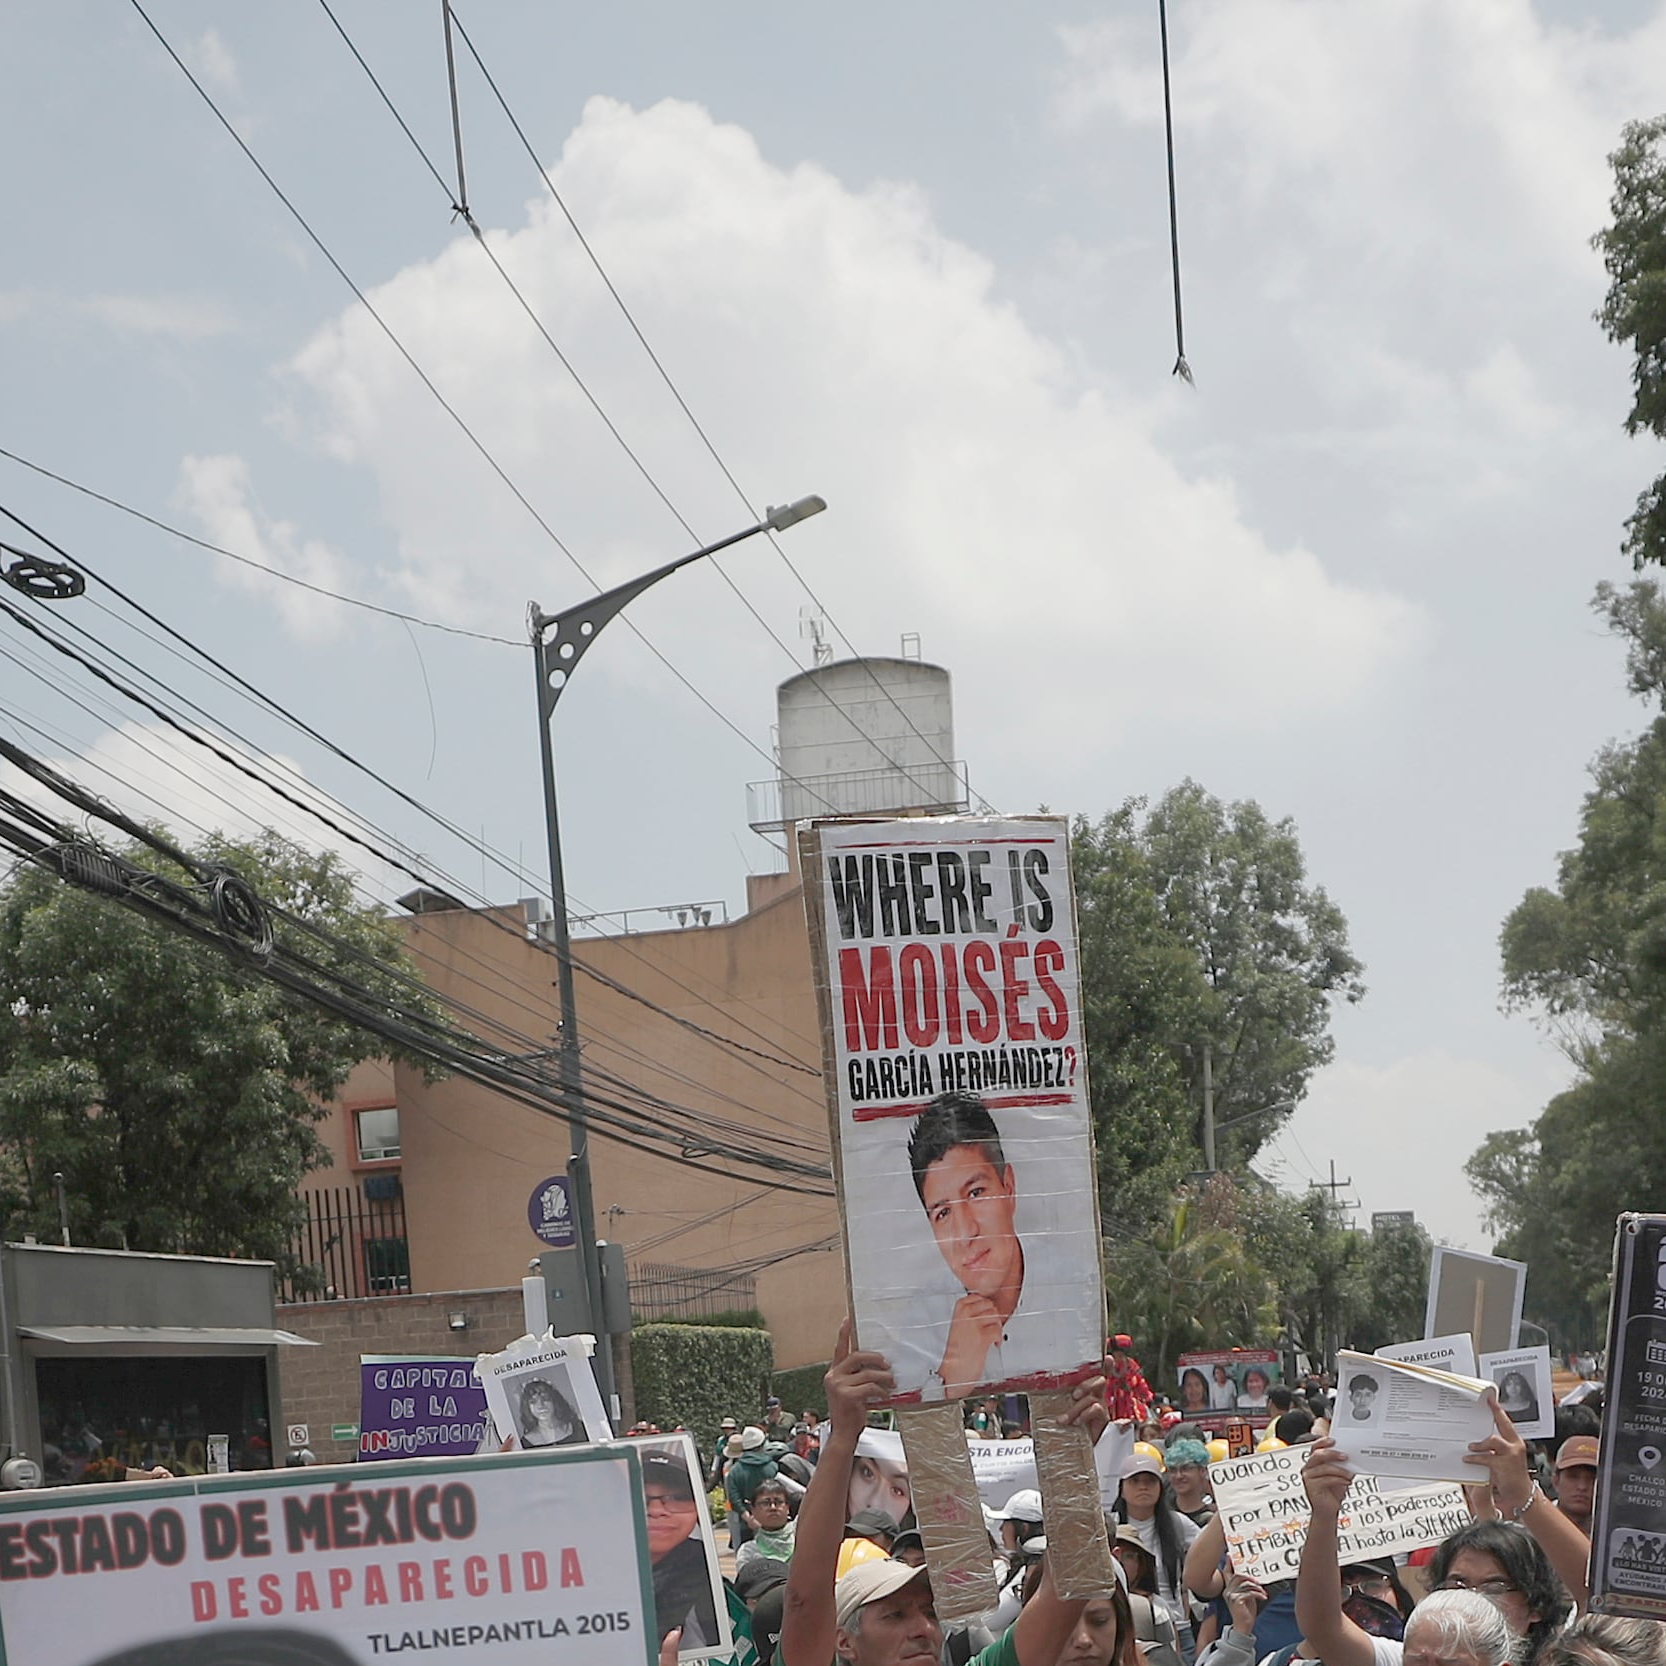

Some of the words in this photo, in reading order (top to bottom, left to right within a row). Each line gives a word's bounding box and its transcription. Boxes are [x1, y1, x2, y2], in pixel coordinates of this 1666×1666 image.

[828, 851, 998, 940] WHERE
[1008, 849, 1053, 932] IS
[838, 924, 1069, 1051] MOISÉS
[848, 1050, 933, 1100] GARCÍA
[939, 1043, 1077, 1094] HERNÁNDEZ?
[494, 1350, 567, 1375] DESAPARECIDA
[1395, 1349, 1455, 1363] APARECIDA
[1637, 1372, 1653, 1384] 19
[391, 1398, 415, 1419] DE
[429, 1396, 457, 1417] LA
[1635, 1415, 1660, 1424] FECHA
[360, 1423, 484, 1453] INJUSTICIA
[1211, 1453, 1291, 1486] Cuando
[1629, 1474, 1665, 1486] CHALCO
[1622, 1485, 1656, 1496] ESTADO
[200, 1499, 272, 1561] DE
[284, 1480, 478, 1556] MÉXICO
[1228, 1508, 1262, 1532] por
[1358, 1510, 1383, 1527] los
[1386, 1489, 1462, 1520] poderosos
[1264, 1558, 1280, 1574] la
[1355, 1528, 1395, 1550] hasta
[1401, 1524, 1415, 1538] la
[1416, 1509, 1472, 1540] SIERRA
[190, 1547, 586, 1623] DESAPARECIDA
[367, 1616, 571, 1656] TLALNEPANTLA
[577, 1611, 631, 1636] 2015
